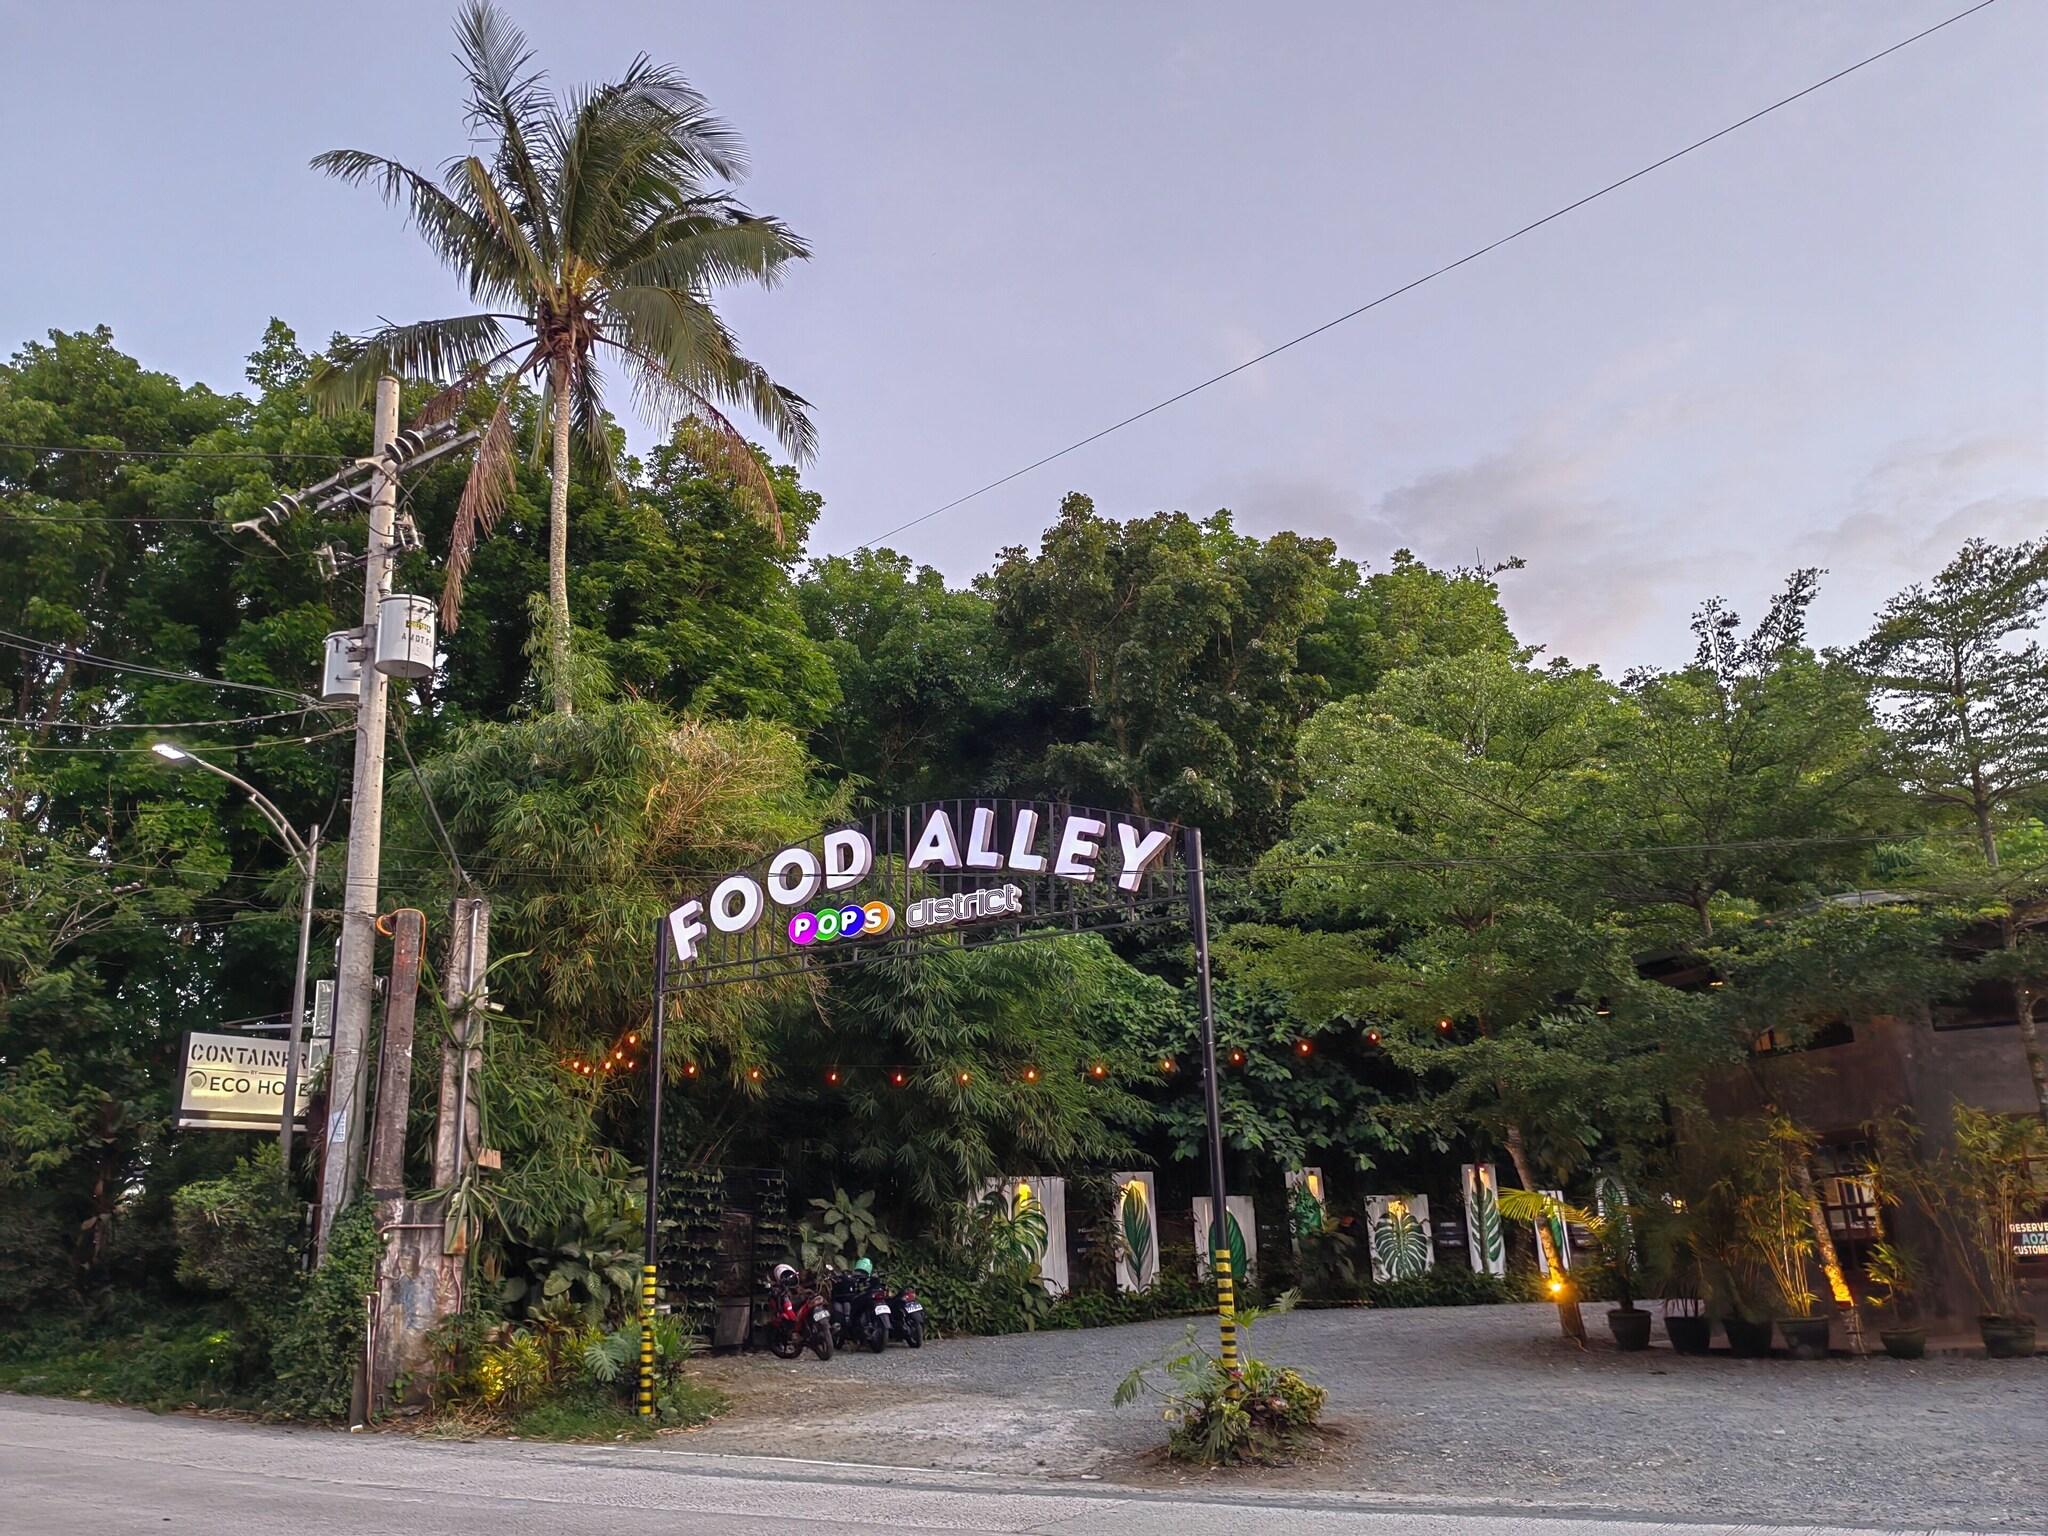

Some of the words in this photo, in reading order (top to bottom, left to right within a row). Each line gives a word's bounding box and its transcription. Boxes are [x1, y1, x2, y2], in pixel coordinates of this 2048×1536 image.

[668, 829, 872, 961] FOOD
[908, 808, 1170, 892] ALLEY
[791, 903, 889, 942] POPS
[905, 884, 1020, 929] district
[210, 1077, 250, 1093] ECO
